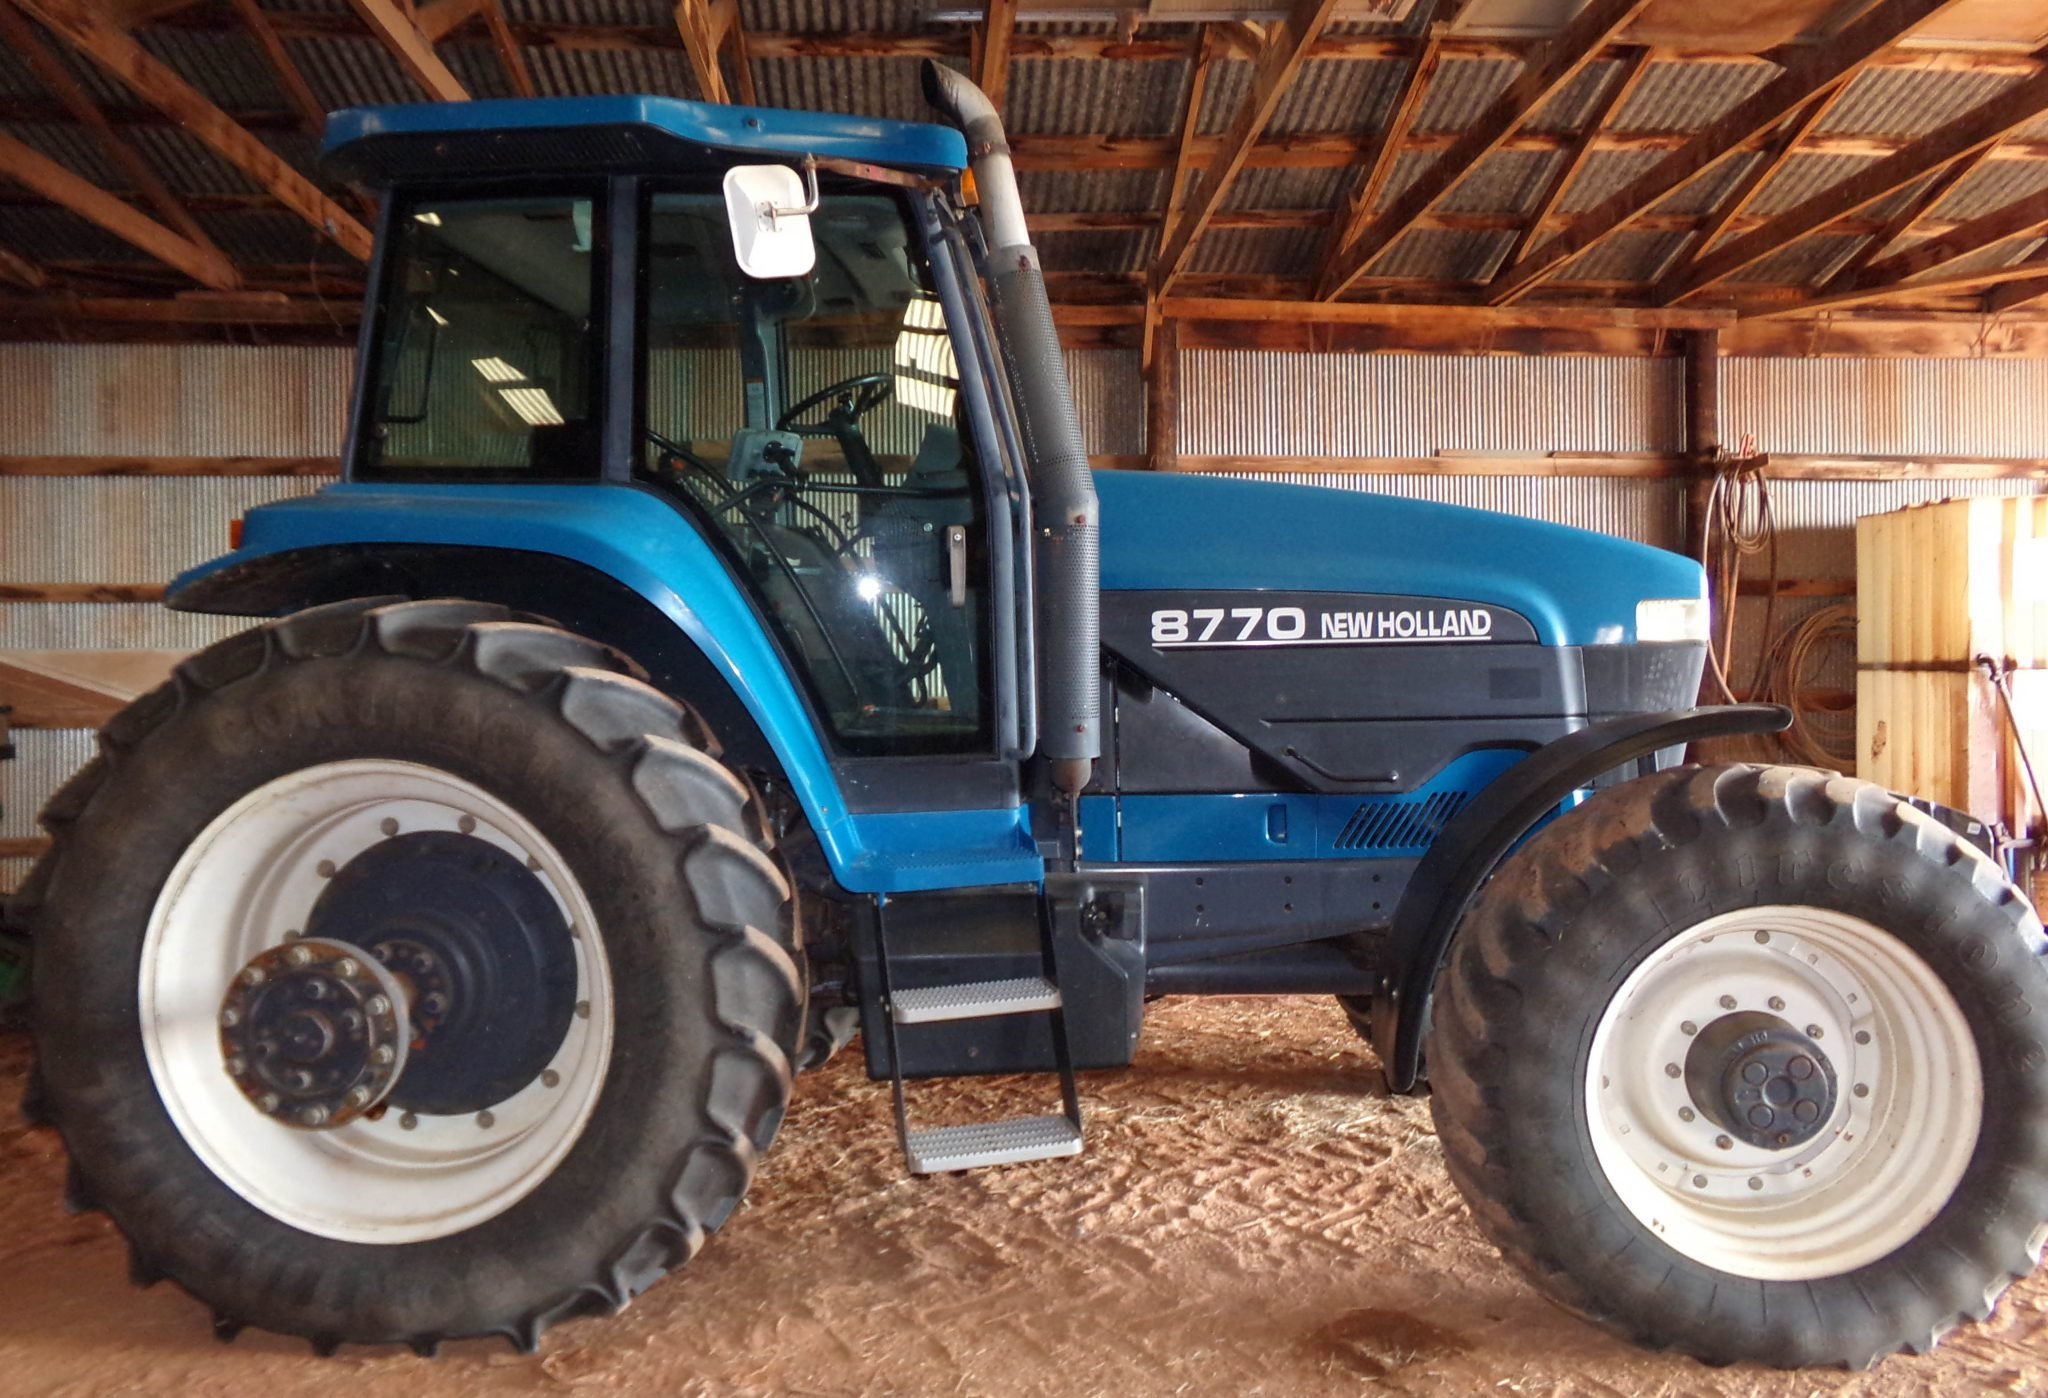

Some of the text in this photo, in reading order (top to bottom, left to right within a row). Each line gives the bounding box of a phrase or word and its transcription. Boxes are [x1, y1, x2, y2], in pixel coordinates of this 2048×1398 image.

[1151, 607, 1492, 642] 8770 NEW HOLLAND
